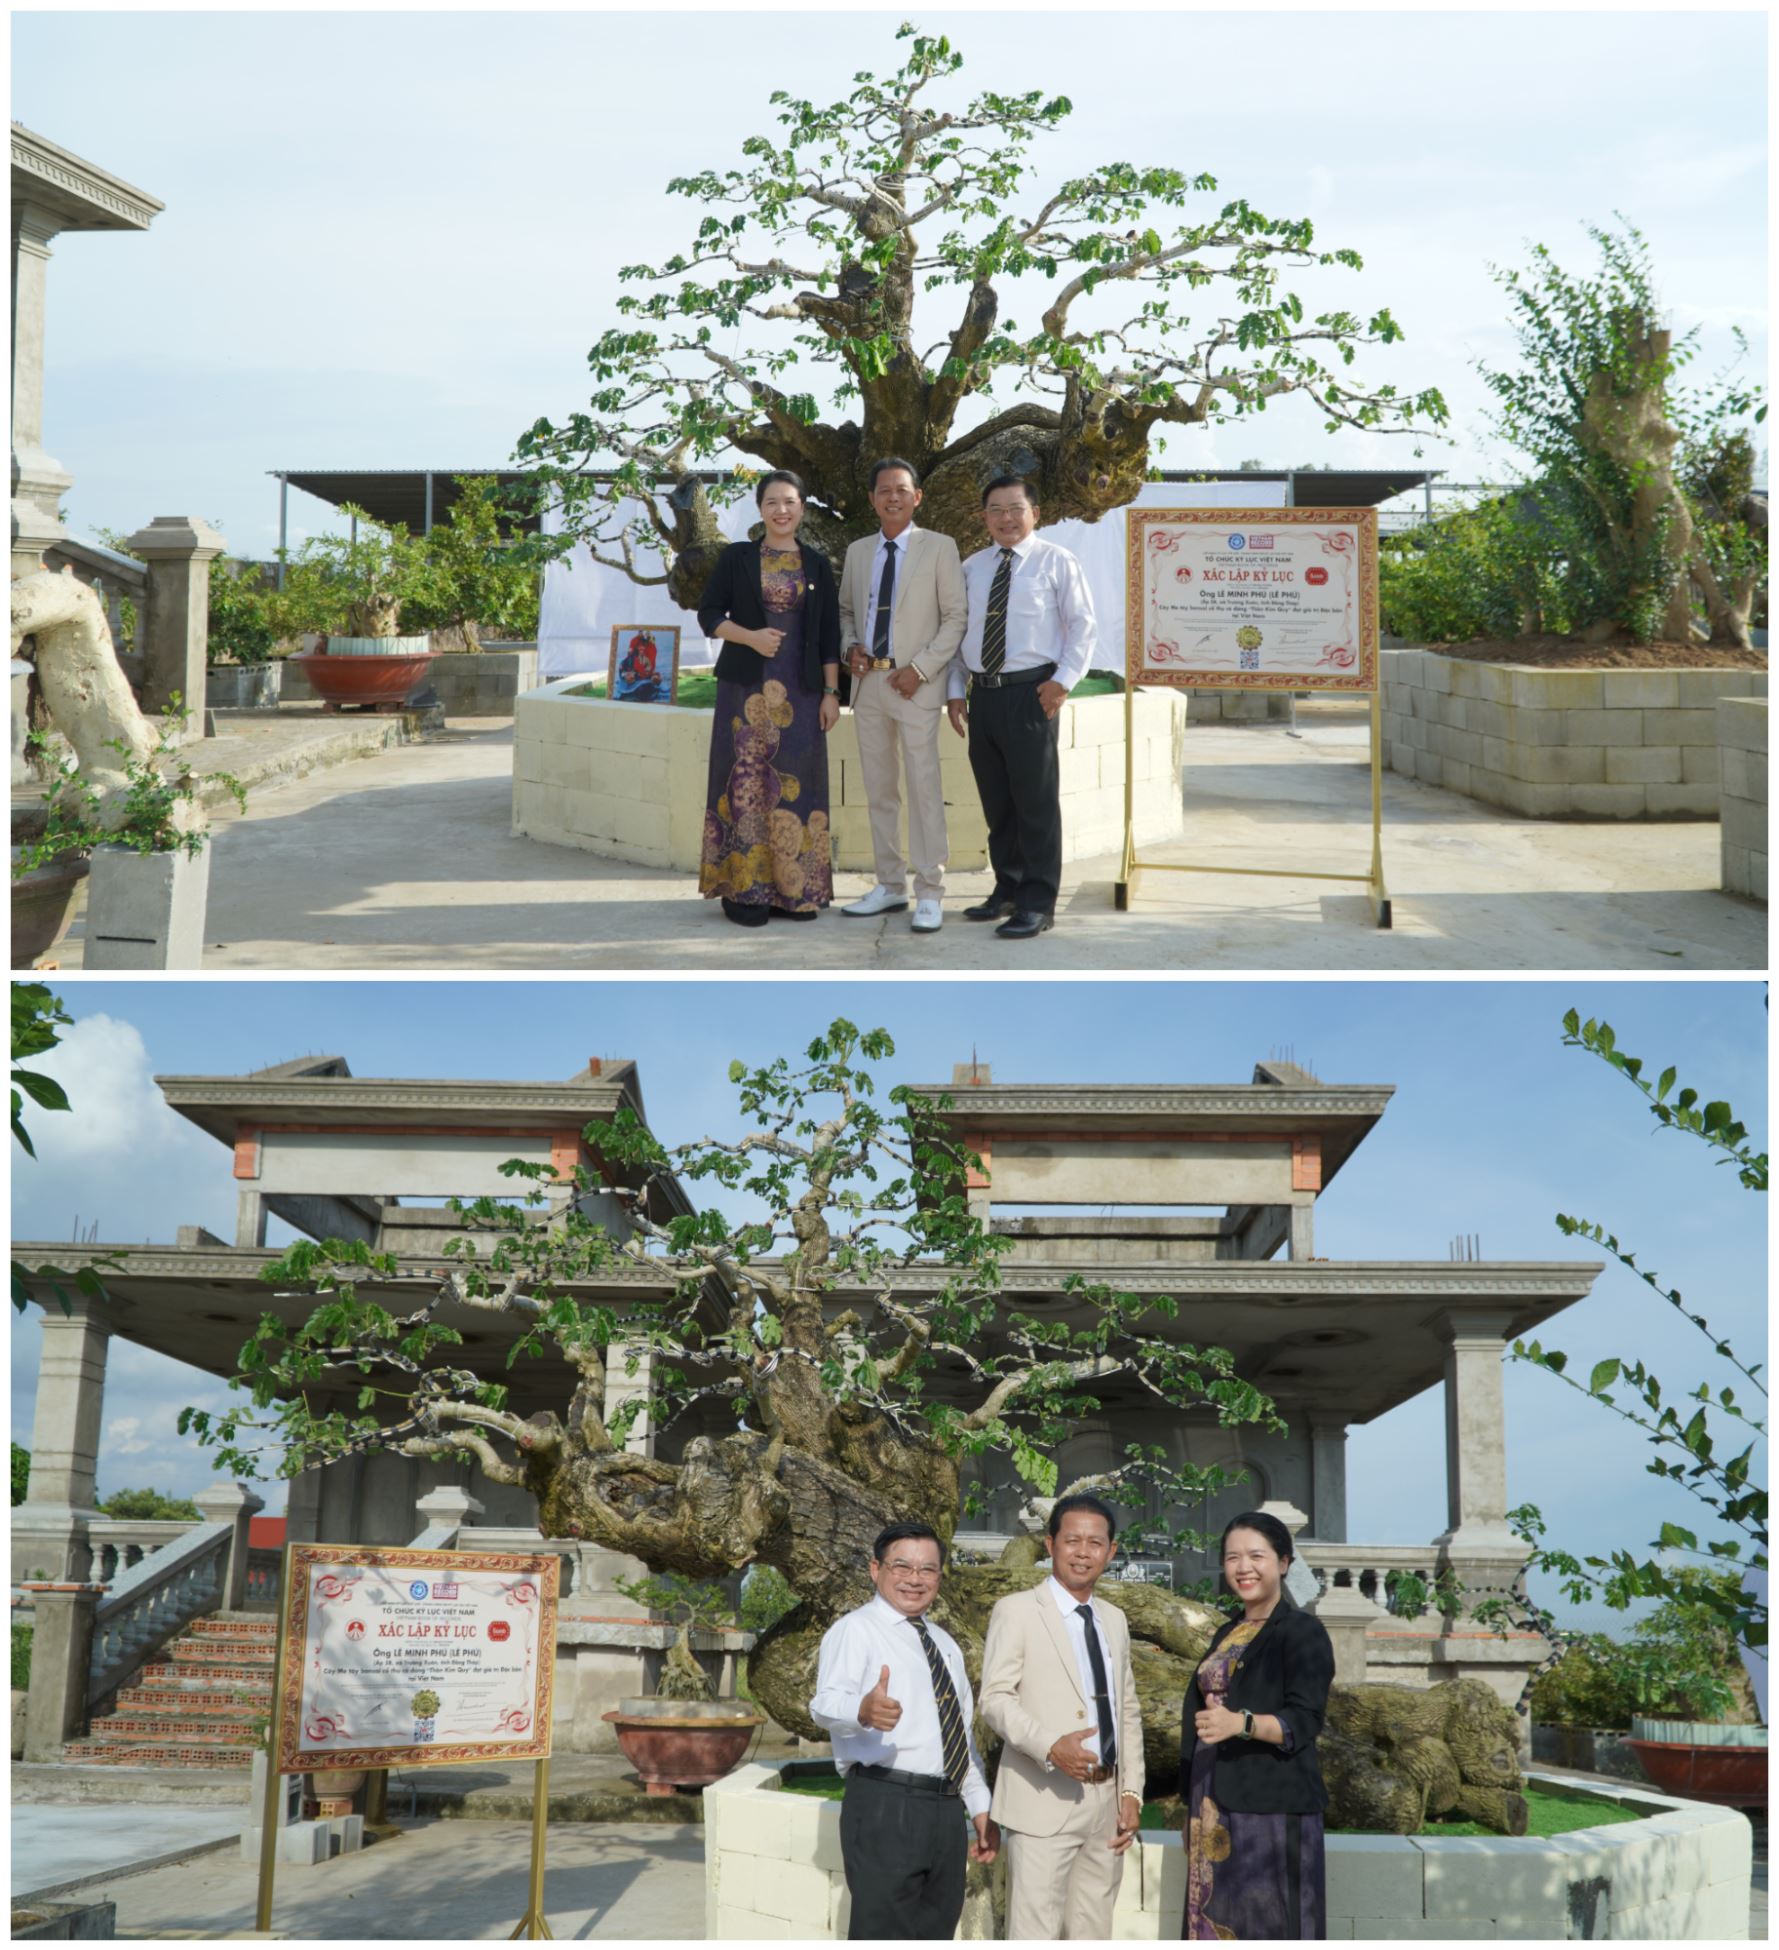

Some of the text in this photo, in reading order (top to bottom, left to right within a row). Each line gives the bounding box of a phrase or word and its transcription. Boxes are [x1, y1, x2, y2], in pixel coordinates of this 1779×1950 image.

[1203, 567, 1226, 581] XÁC
[1229, 568, 1250, 584] LẬP
[1252, 567, 1269, 582] KỶ
[1272, 571, 1295, 584] LỤC
[1200, 589, 1216, 598] Ông
[378, 1621, 405, 1637] XÁC
[408, 1622, 431, 1640] LẬP
[434, 1620, 450, 1638] KỶ
[454, 1625, 477, 1640] LỤC
[373, 1648, 391, 1658] Ông
[404, 1649, 428, 1657] MINH
